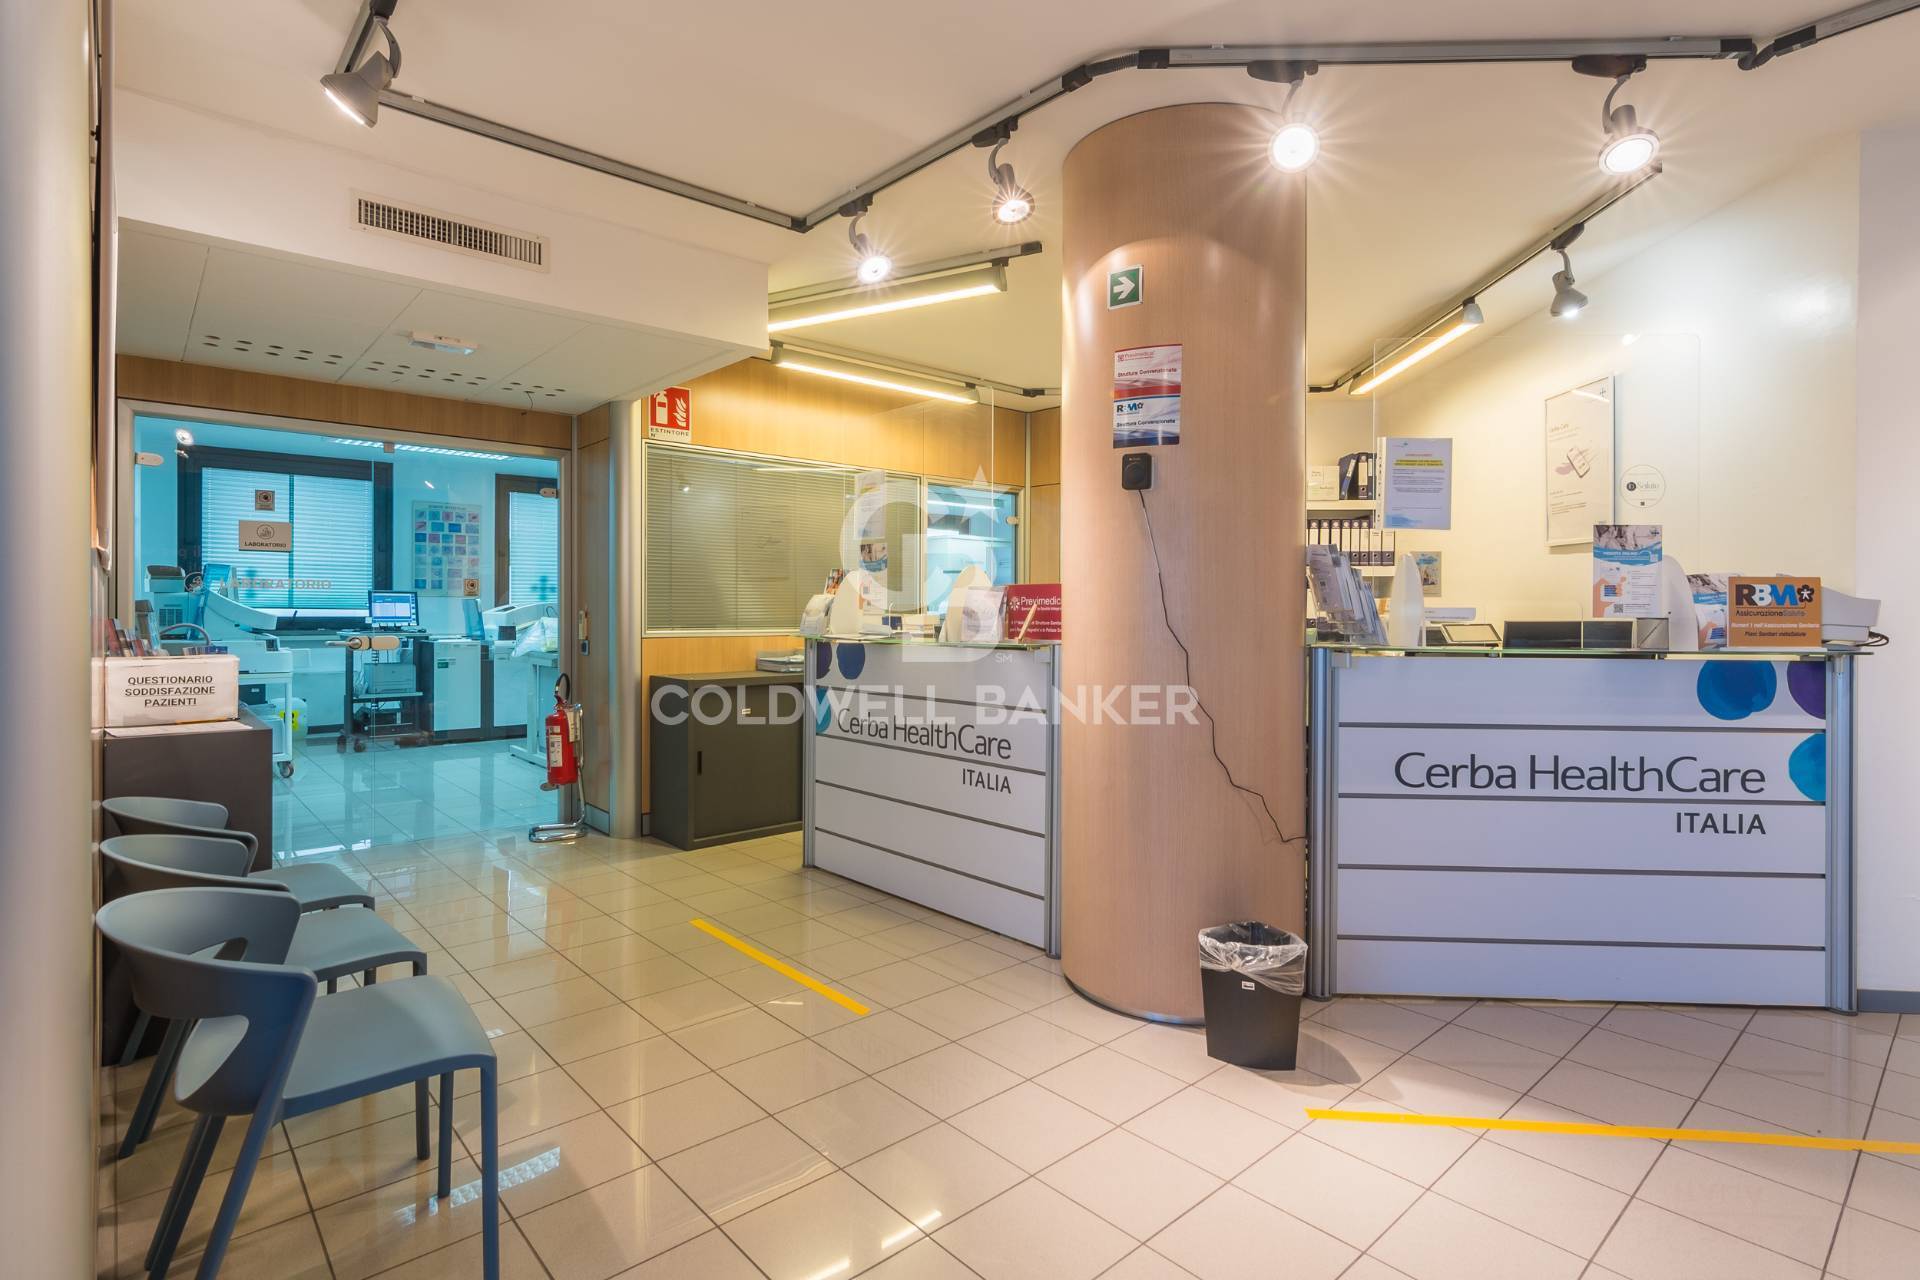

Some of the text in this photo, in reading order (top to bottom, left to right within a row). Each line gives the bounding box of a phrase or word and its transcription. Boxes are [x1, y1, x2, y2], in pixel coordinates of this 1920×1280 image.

[650, 427, 689, 436] ESTINTORE
[219, 577, 331, 590] LABORATORIO
[1735, 584, 1799, 607] RBM
[127, 675, 213, 686] QUESTIONARIO
[125, 686, 216, 696] SODDISFAZIONE
[144, 698, 197, 707] PAZIENTI
[838, 708, 1012, 759] Cerba HealthCare
[962, 768, 1012, 794] ITALIA
[1394, 752, 1766, 794] Cerba HealthCare
[1675, 812, 1766, 835] ITALIA
